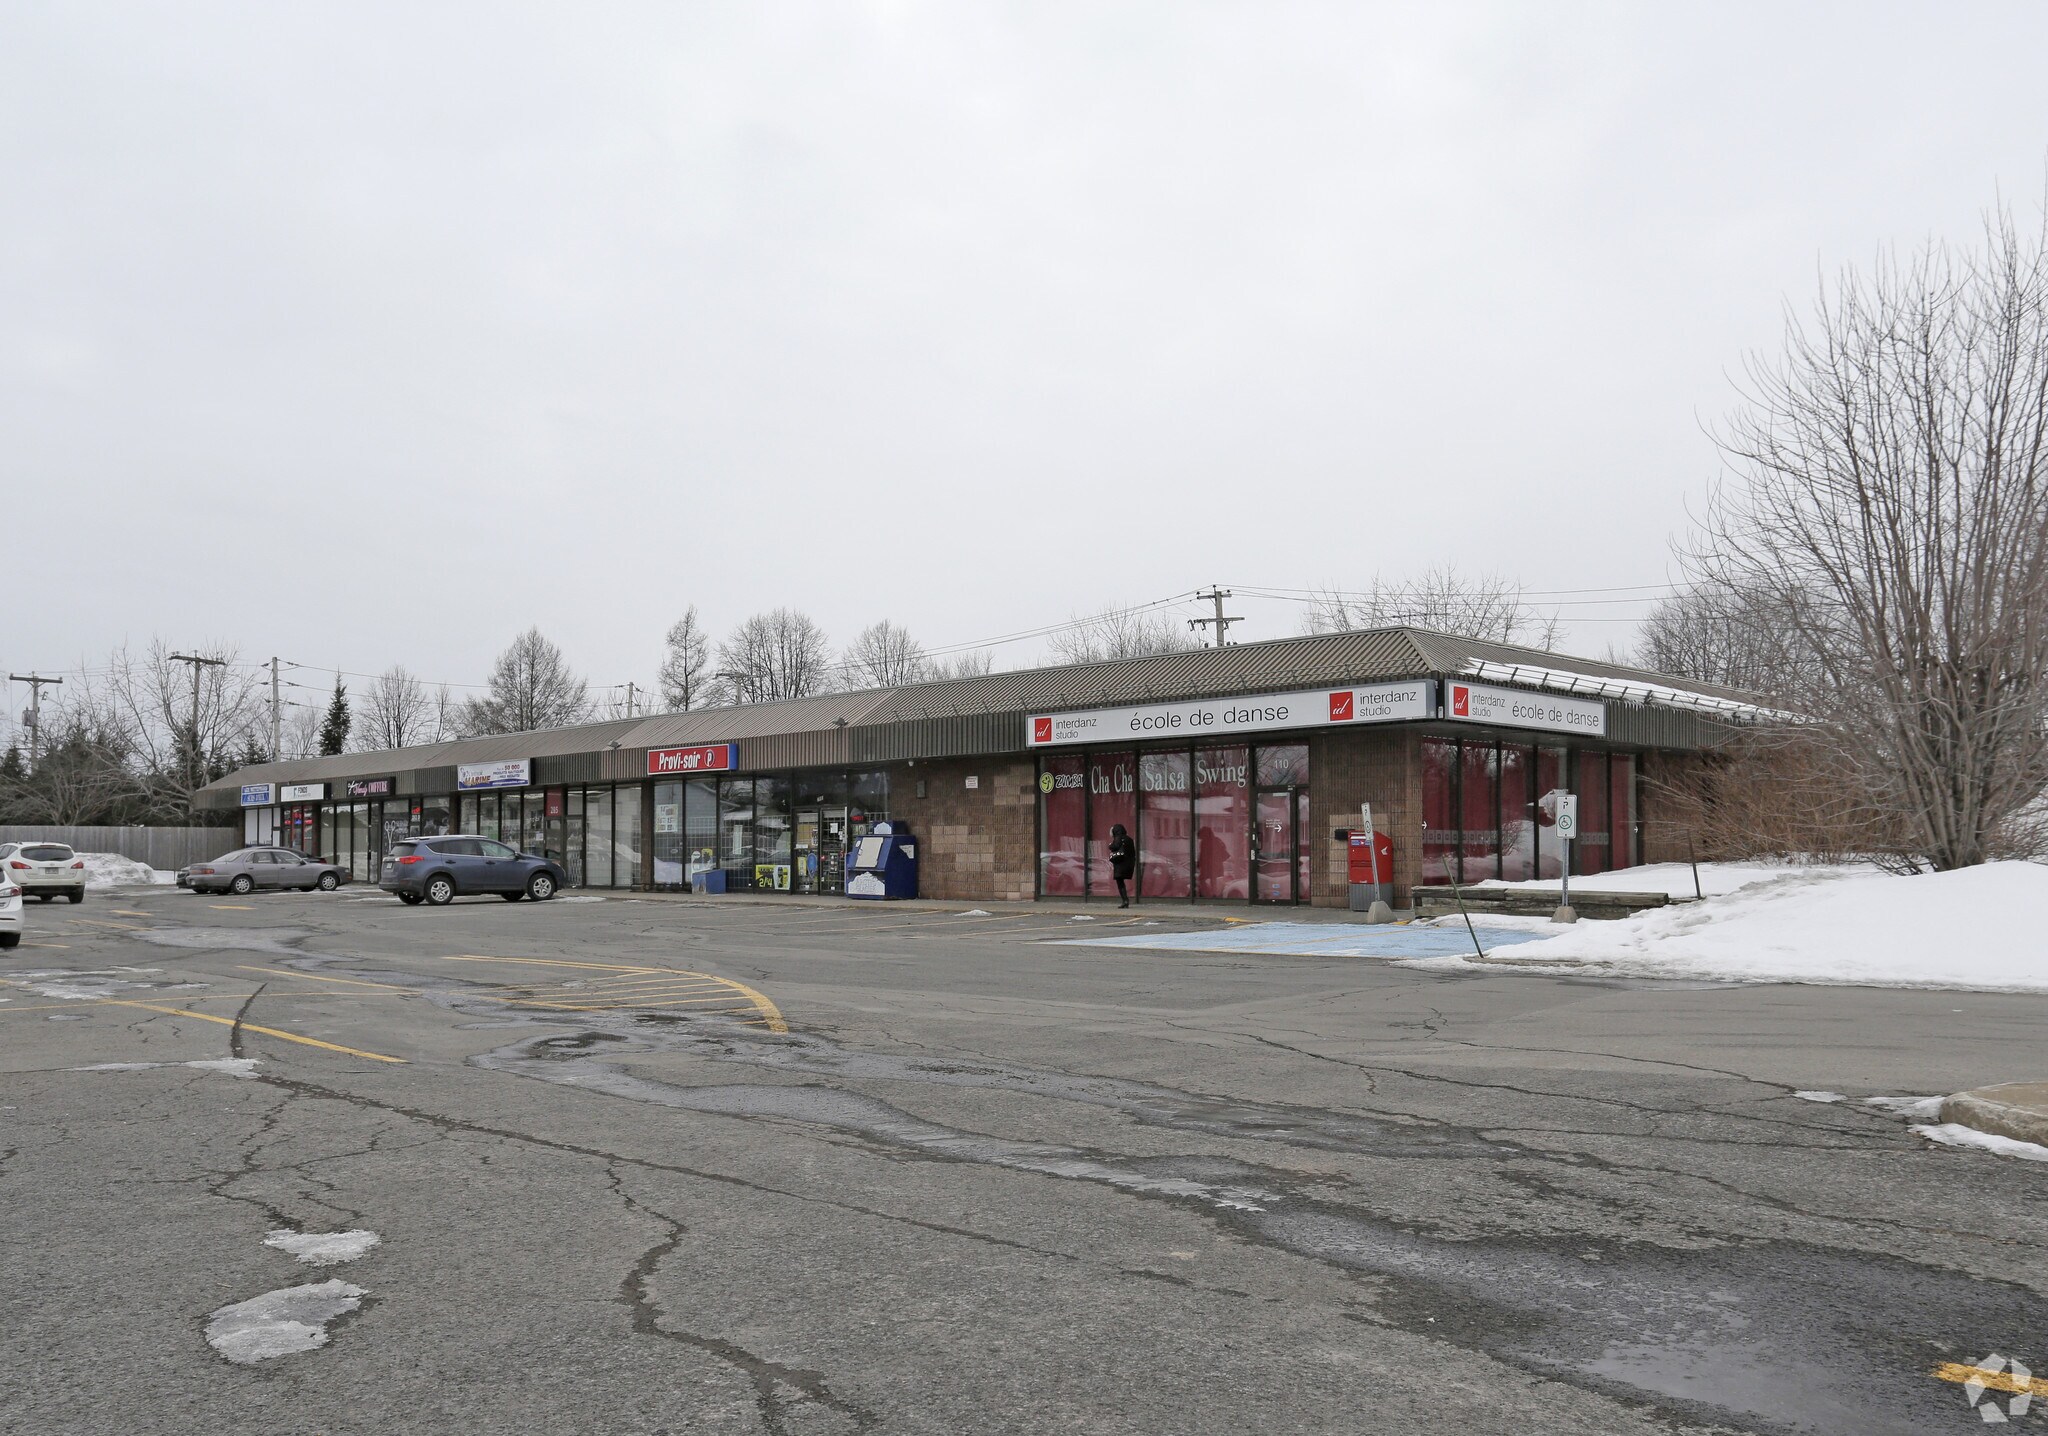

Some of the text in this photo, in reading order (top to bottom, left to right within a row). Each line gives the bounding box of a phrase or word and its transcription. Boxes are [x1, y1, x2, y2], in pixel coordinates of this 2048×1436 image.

[1360, 691, 1416, 704] interdanz
[1472, 692, 1505, 708] interdanz
[1130, 706, 1289, 730] école de danse
[1360, 705, 1391, 716] studio
[1472, 706, 1491, 718] studio
[1512, 701, 1599, 727] école de danse
[1055, 718, 1097, 729] interdanz
[1055, 730, 1079, 739] studio
[658, 751, 701, 770] Provi-soir
[1274, 759, 1289, 769] 110
[1091, 763, 1133, 794] Cha Cha
[1145, 762, 1185, 791] Salsa
[1197, 759, 1246, 788] Swing
